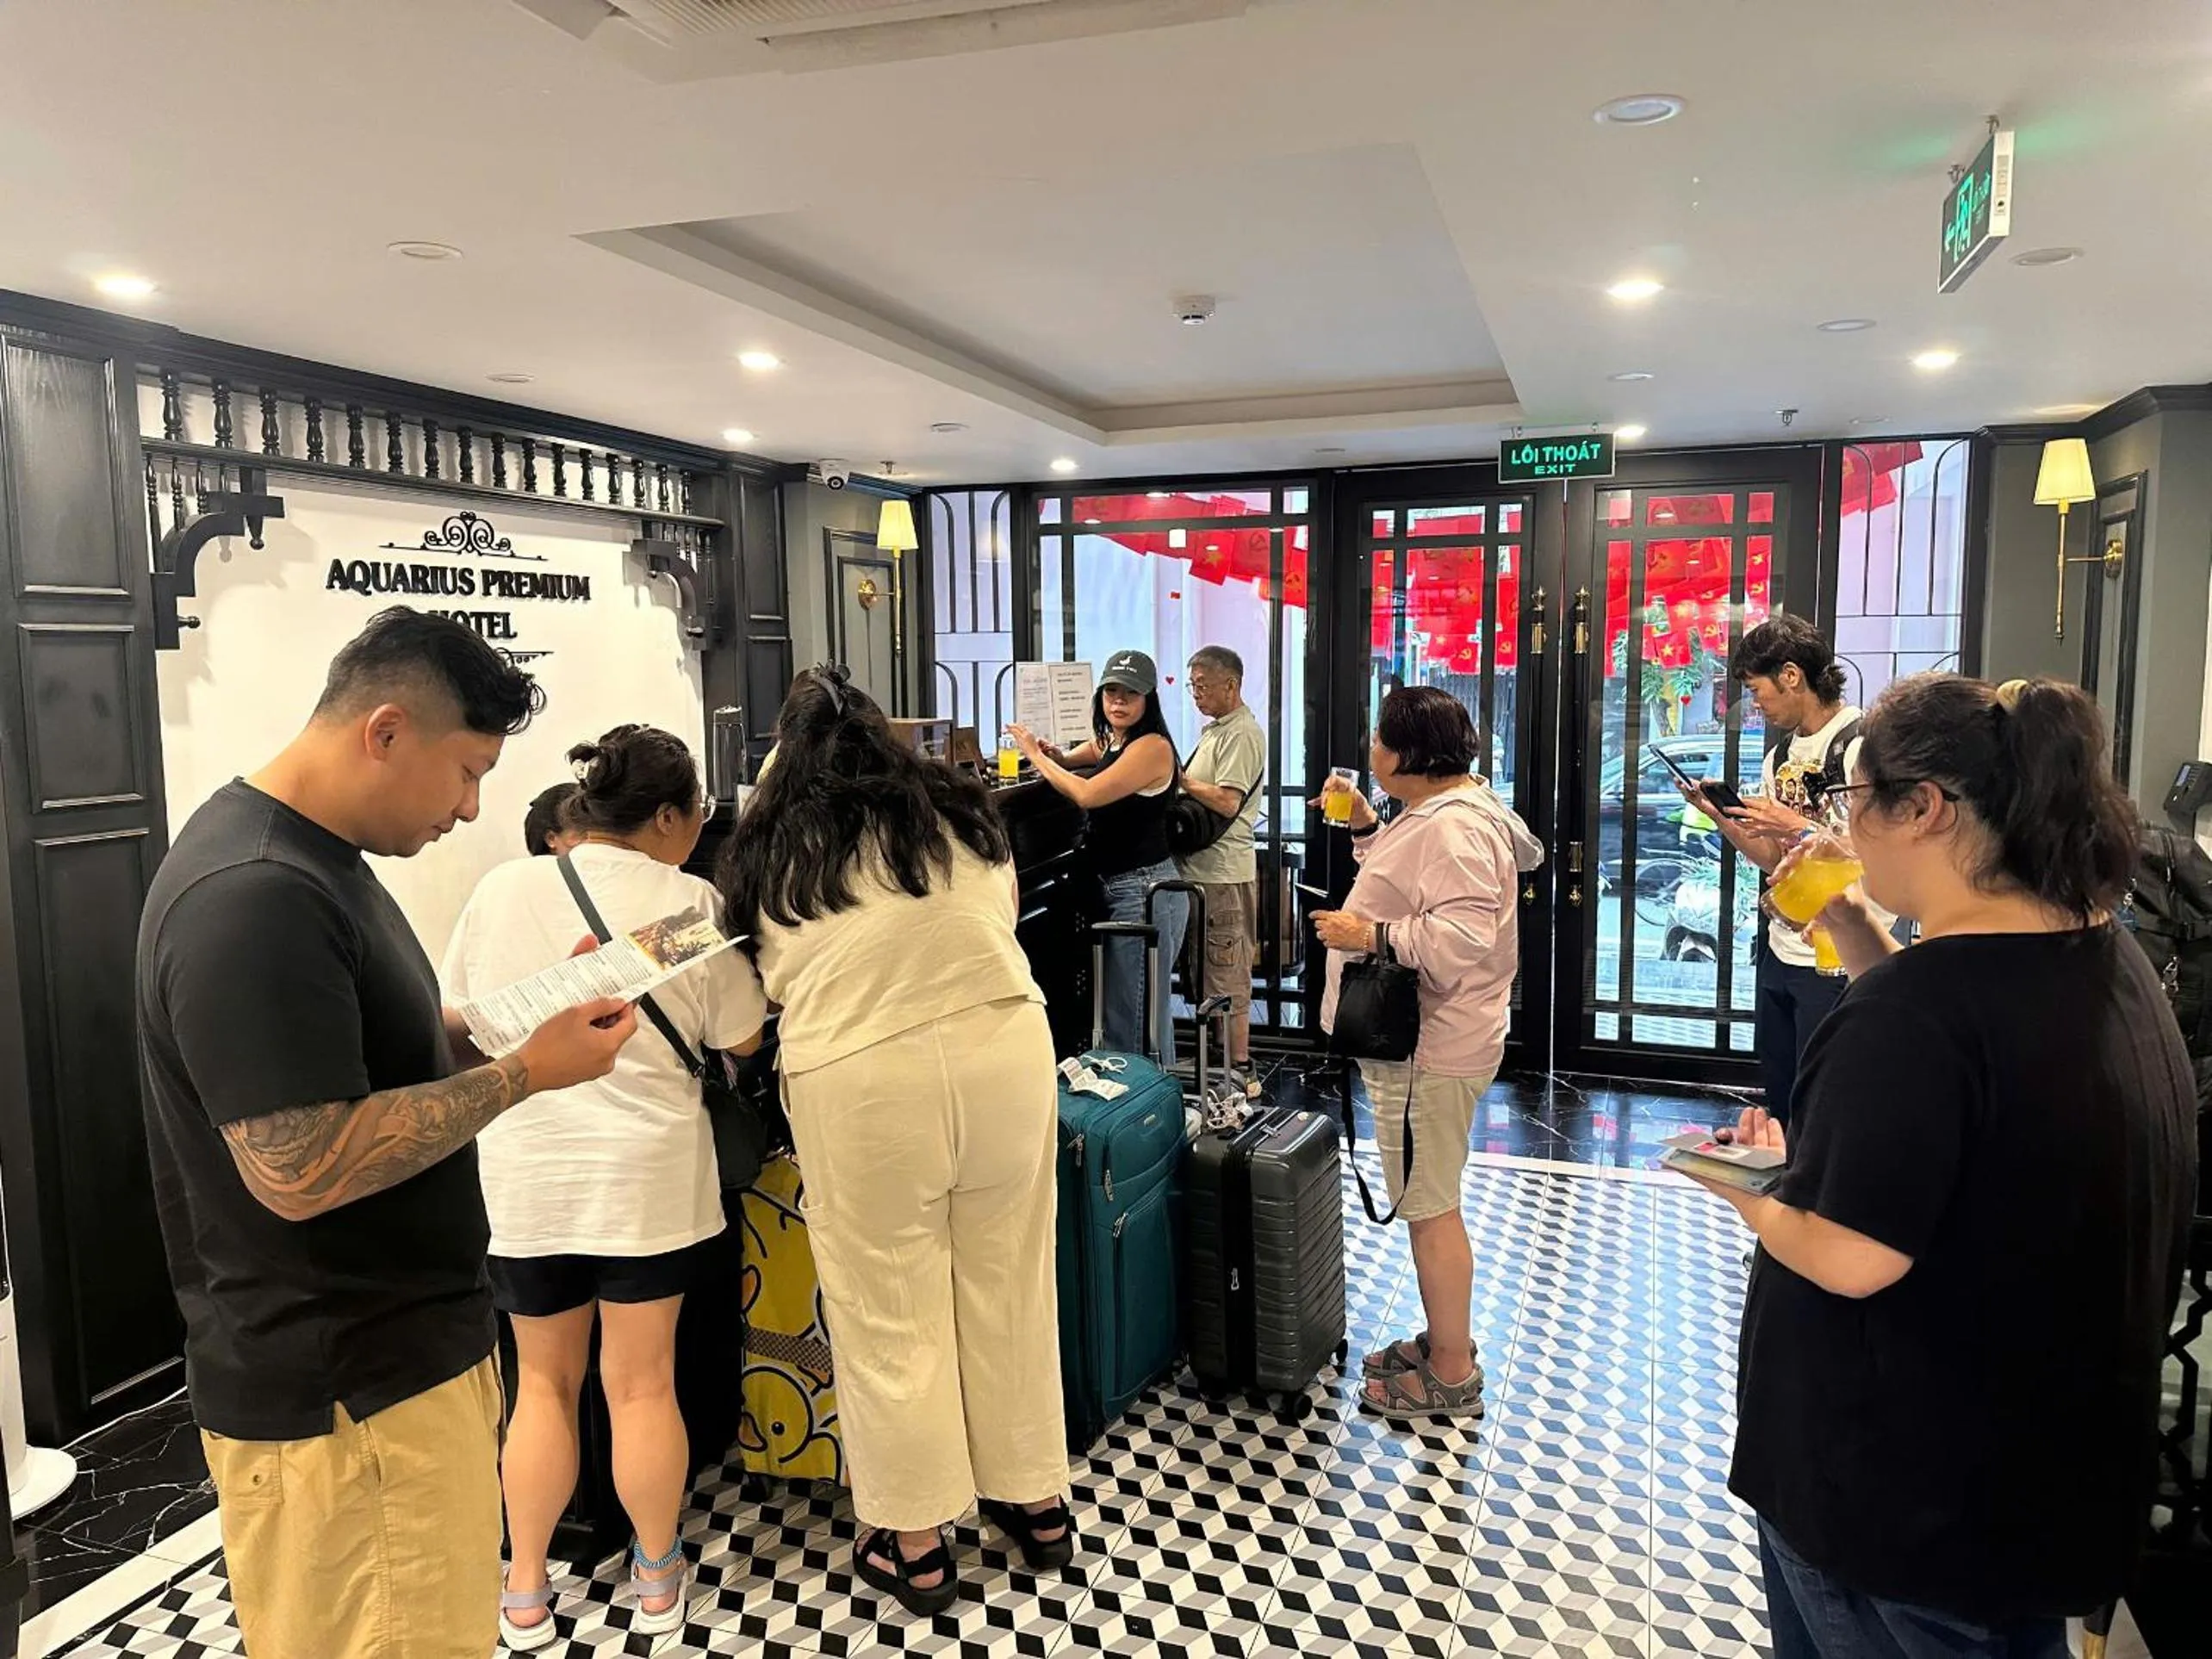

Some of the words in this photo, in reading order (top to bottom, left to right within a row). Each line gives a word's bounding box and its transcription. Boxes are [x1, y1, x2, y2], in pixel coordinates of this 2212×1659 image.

[1542, 440, 1601, 462] THOÁT
[1534, 463, 1577, 475] EXIT
[326, 558, 475, 596] AQUARIUS
[481, 569, 592, 601] PREMIUM
[427, 609, 518, 640] OTEL
